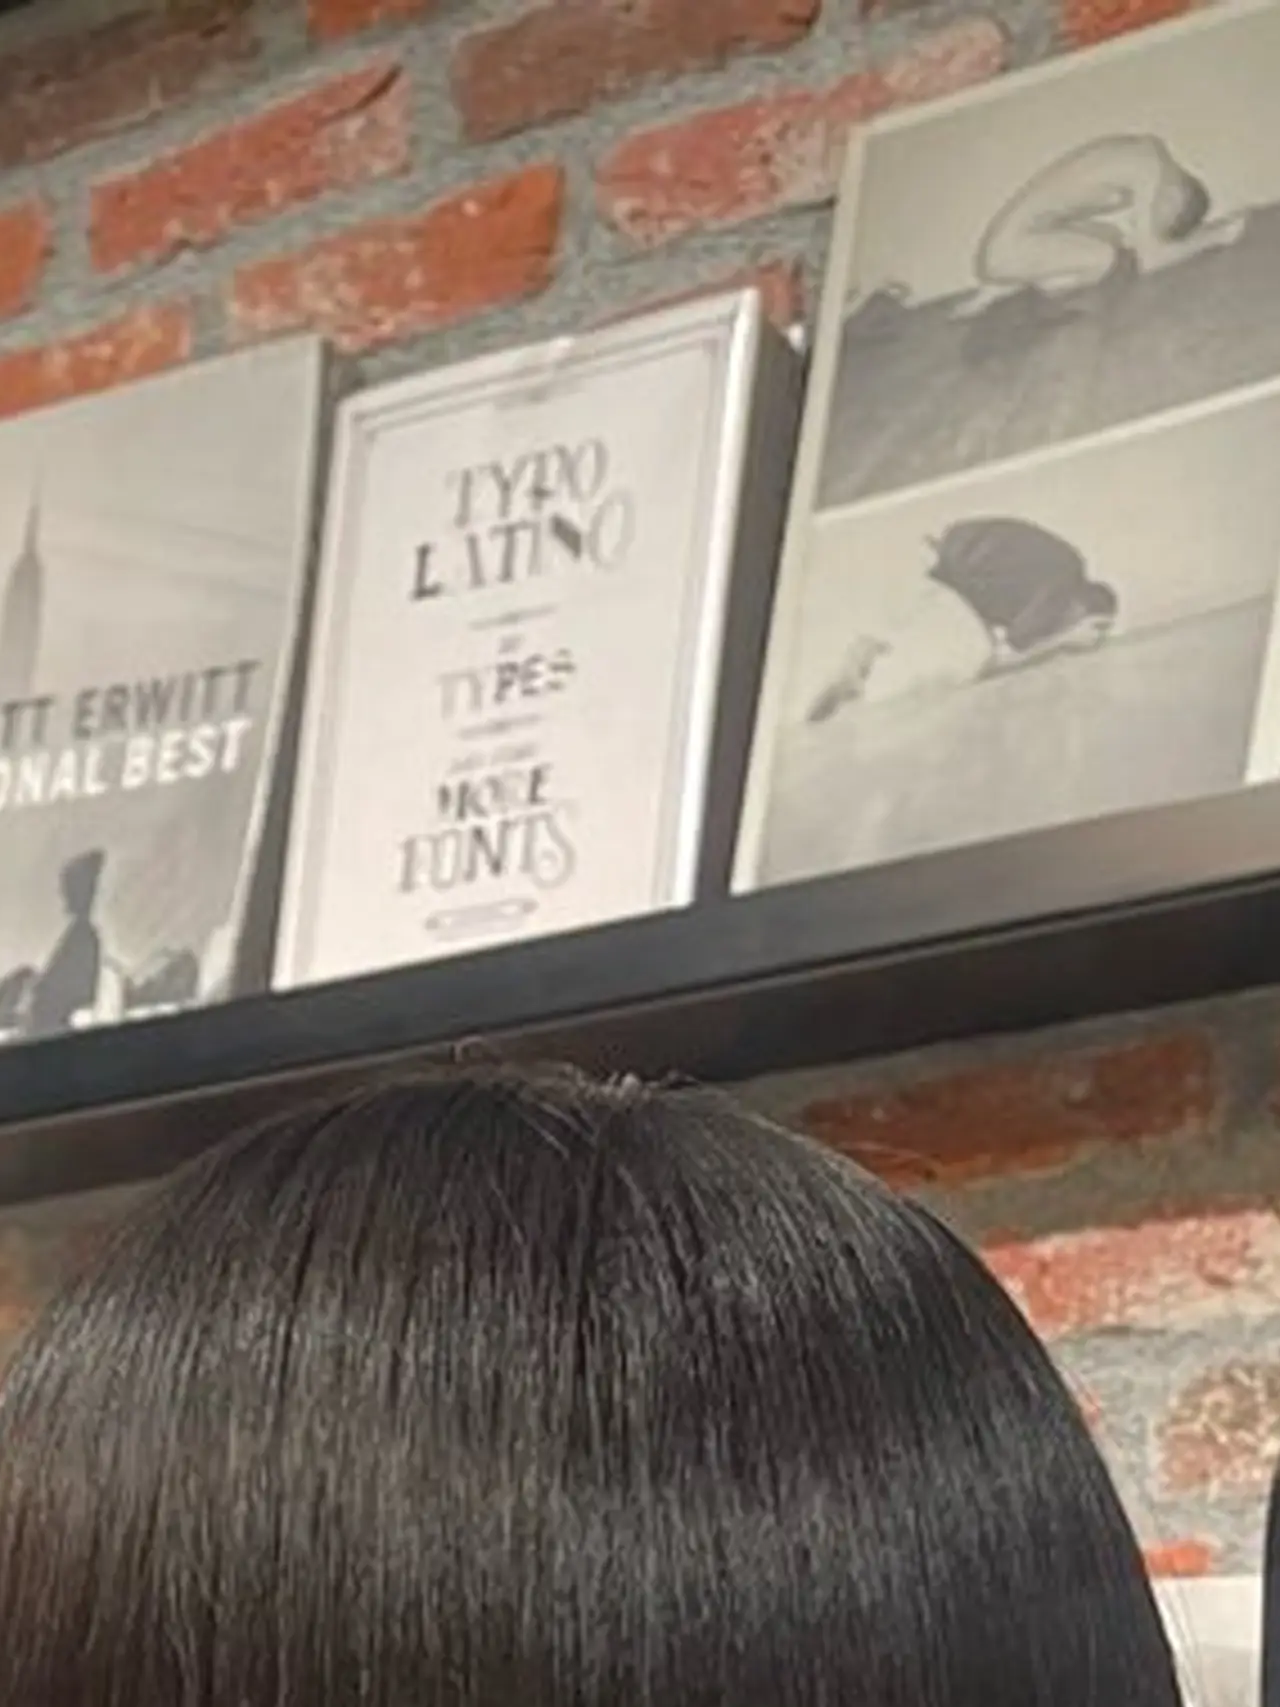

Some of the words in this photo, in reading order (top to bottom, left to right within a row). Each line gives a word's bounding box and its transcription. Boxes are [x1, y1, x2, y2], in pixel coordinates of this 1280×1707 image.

[445, 437, 610, 528] TYPO
[73, 658, 260, 740] ERWITT
[437, 649, 576, 720] TYPES
[121, 717, 251, 790] BEST
